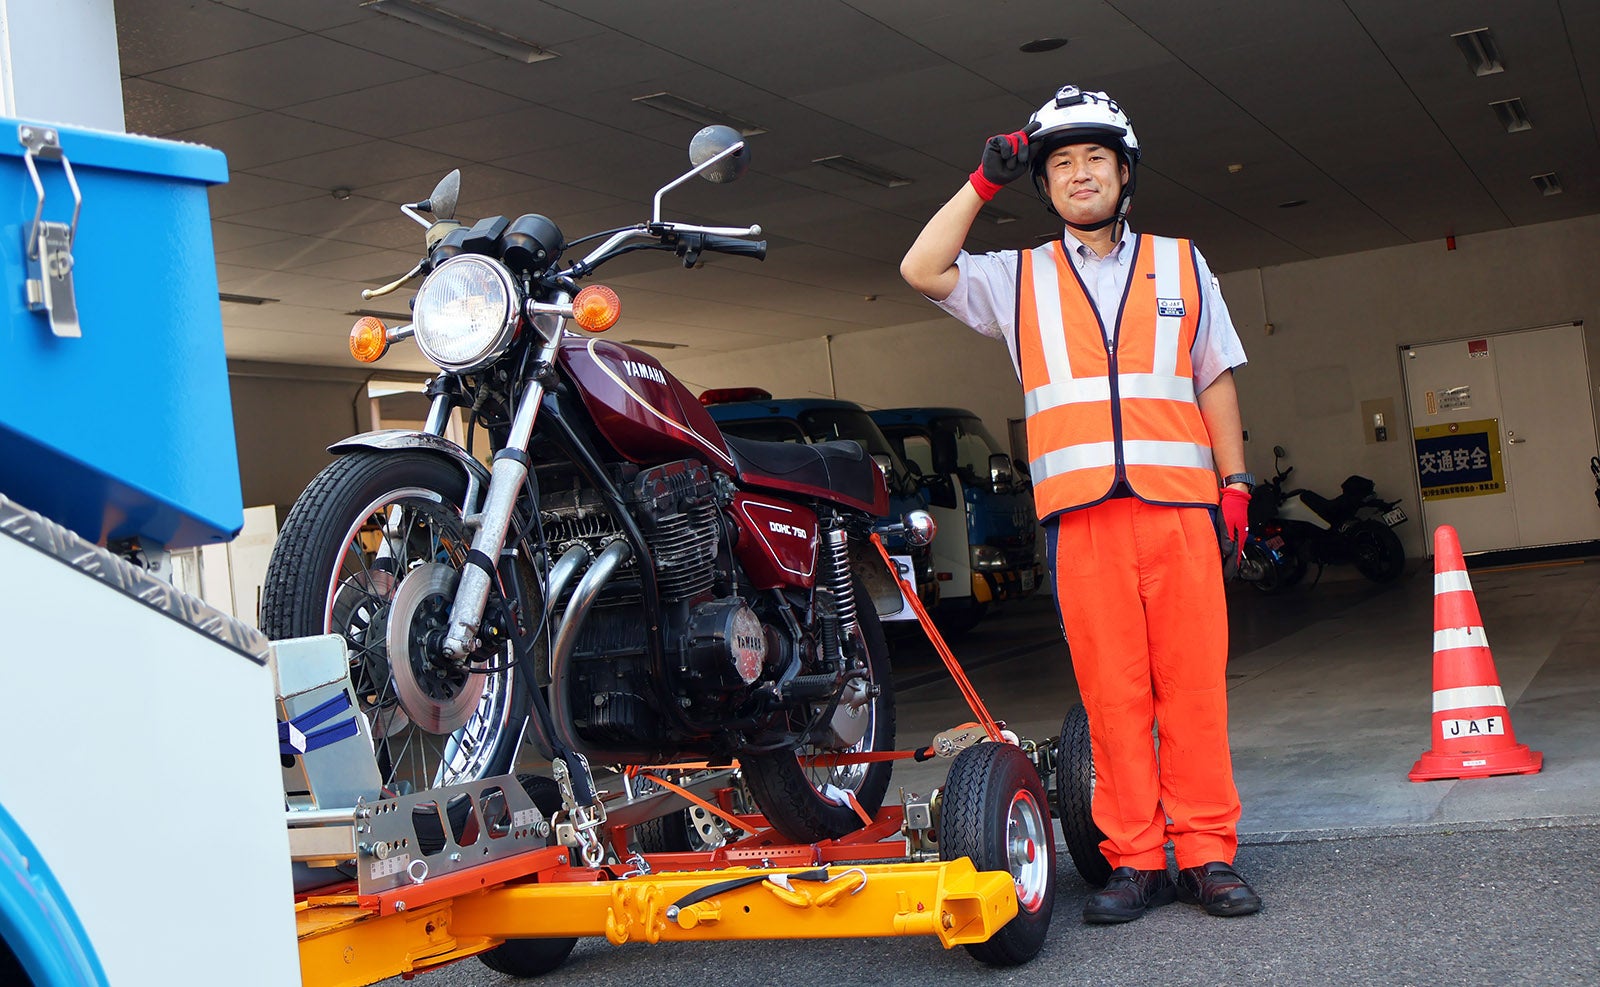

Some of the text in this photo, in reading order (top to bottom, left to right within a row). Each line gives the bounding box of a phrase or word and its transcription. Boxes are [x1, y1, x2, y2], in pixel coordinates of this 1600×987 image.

[622, 360, 667, 385] YAMAHA
[1419, 446, 1488, 475] 交通安全
[769, 521, 807, 539] DOHC 750
[737, 635, 762, 651] YAMAHA
